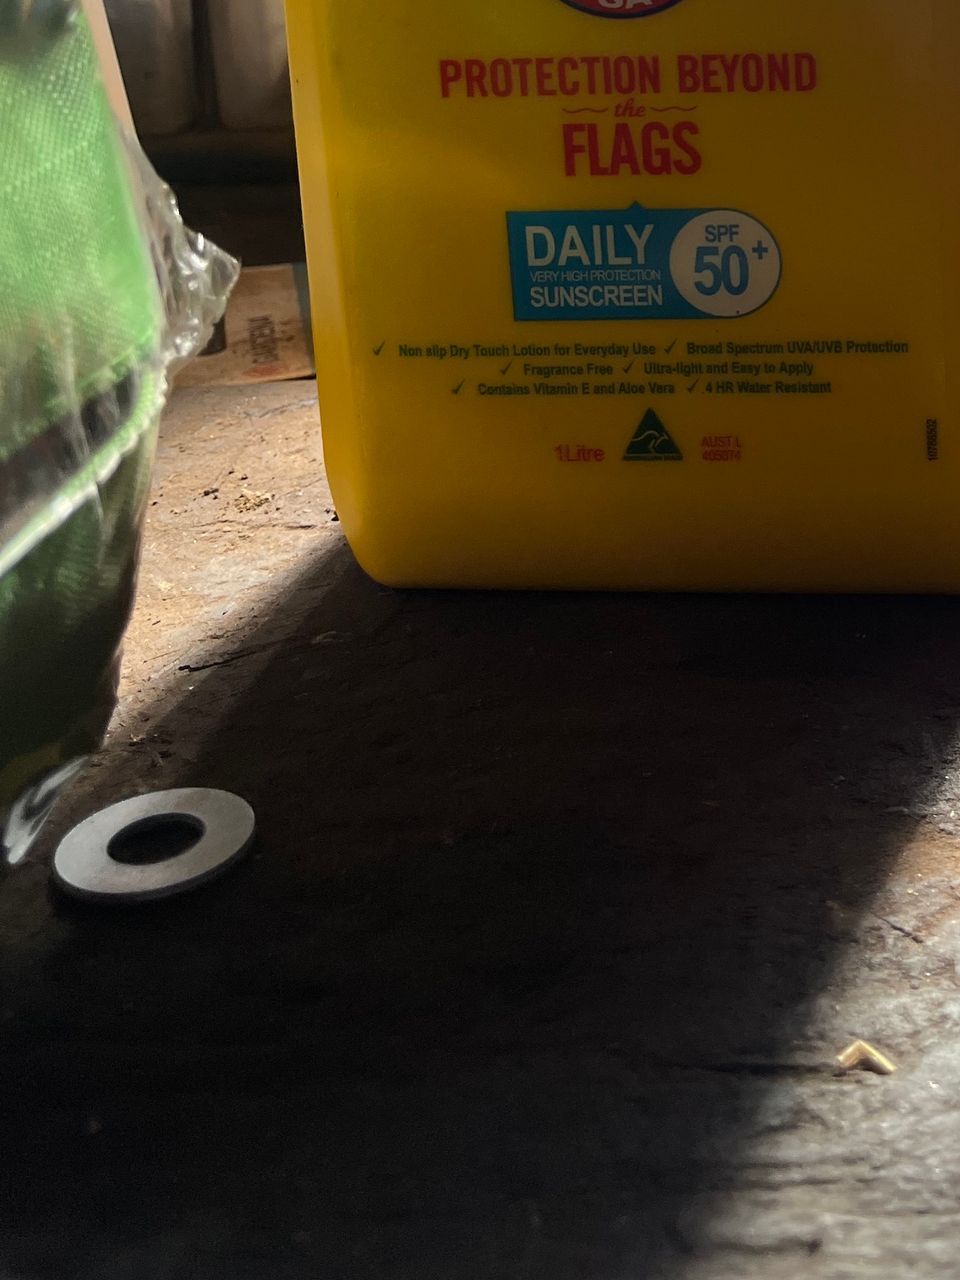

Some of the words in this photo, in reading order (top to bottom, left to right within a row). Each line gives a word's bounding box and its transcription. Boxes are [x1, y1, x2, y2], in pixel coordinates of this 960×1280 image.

[440, 55, 661, 98] PROTECTION
[677, 52, 817, 93] BEYOND
[614, 98, 646, 118] the
[562, 121, 702, 176] FLAGS
[705, 224, 739, 242] SPF
[525, 224, 654, 267] DAILY
[529, 270, 559, 282] VERY
[561, 270, 589, 282] HIGH
[590, 269, 661, 281] PROTECTION
[530, 284, 663, 308] SUNSCREEN
[398, 344, 422, 357] Non
[426, 343, 447, 359] slip
[450, 344, 469, 359] Dry
[473, 344, 510, 357] Touch
[513, 344, 550, 356] Lotion
[554, 344, 572, 356] for
[574, 343, 629, 359] Everyday
[632, 342, 656, 355] Use
[687, 342, 722, 355] Broad
[726, 341, 783, 357] Spectrum
[787, 341, 842, 353] UVA/UVB
[846, 340, 908, 353] Protection
[523, 363, 583, 378] Fragrance
[587, 363, 613, 375] Free
[644, 362, 702, 377] Ultra-light
[706, 362, 728, 374] and
[731, 361, 761, 377] Easy
[764, 362, 776, 374] to
[779, 361, 814, 377] Apply
[477, 383, 530, 395] Contains
[533, 383, 578, 395] Vitamin
[581, 383, 589, 394] E
[593, 383, 615, 394] and
[619, 382, 644, 394] Aloe
[649, 382, 675, 394] Vera
[716, 382, 734, 393] HR
[737, 381, 770, 393] Water
